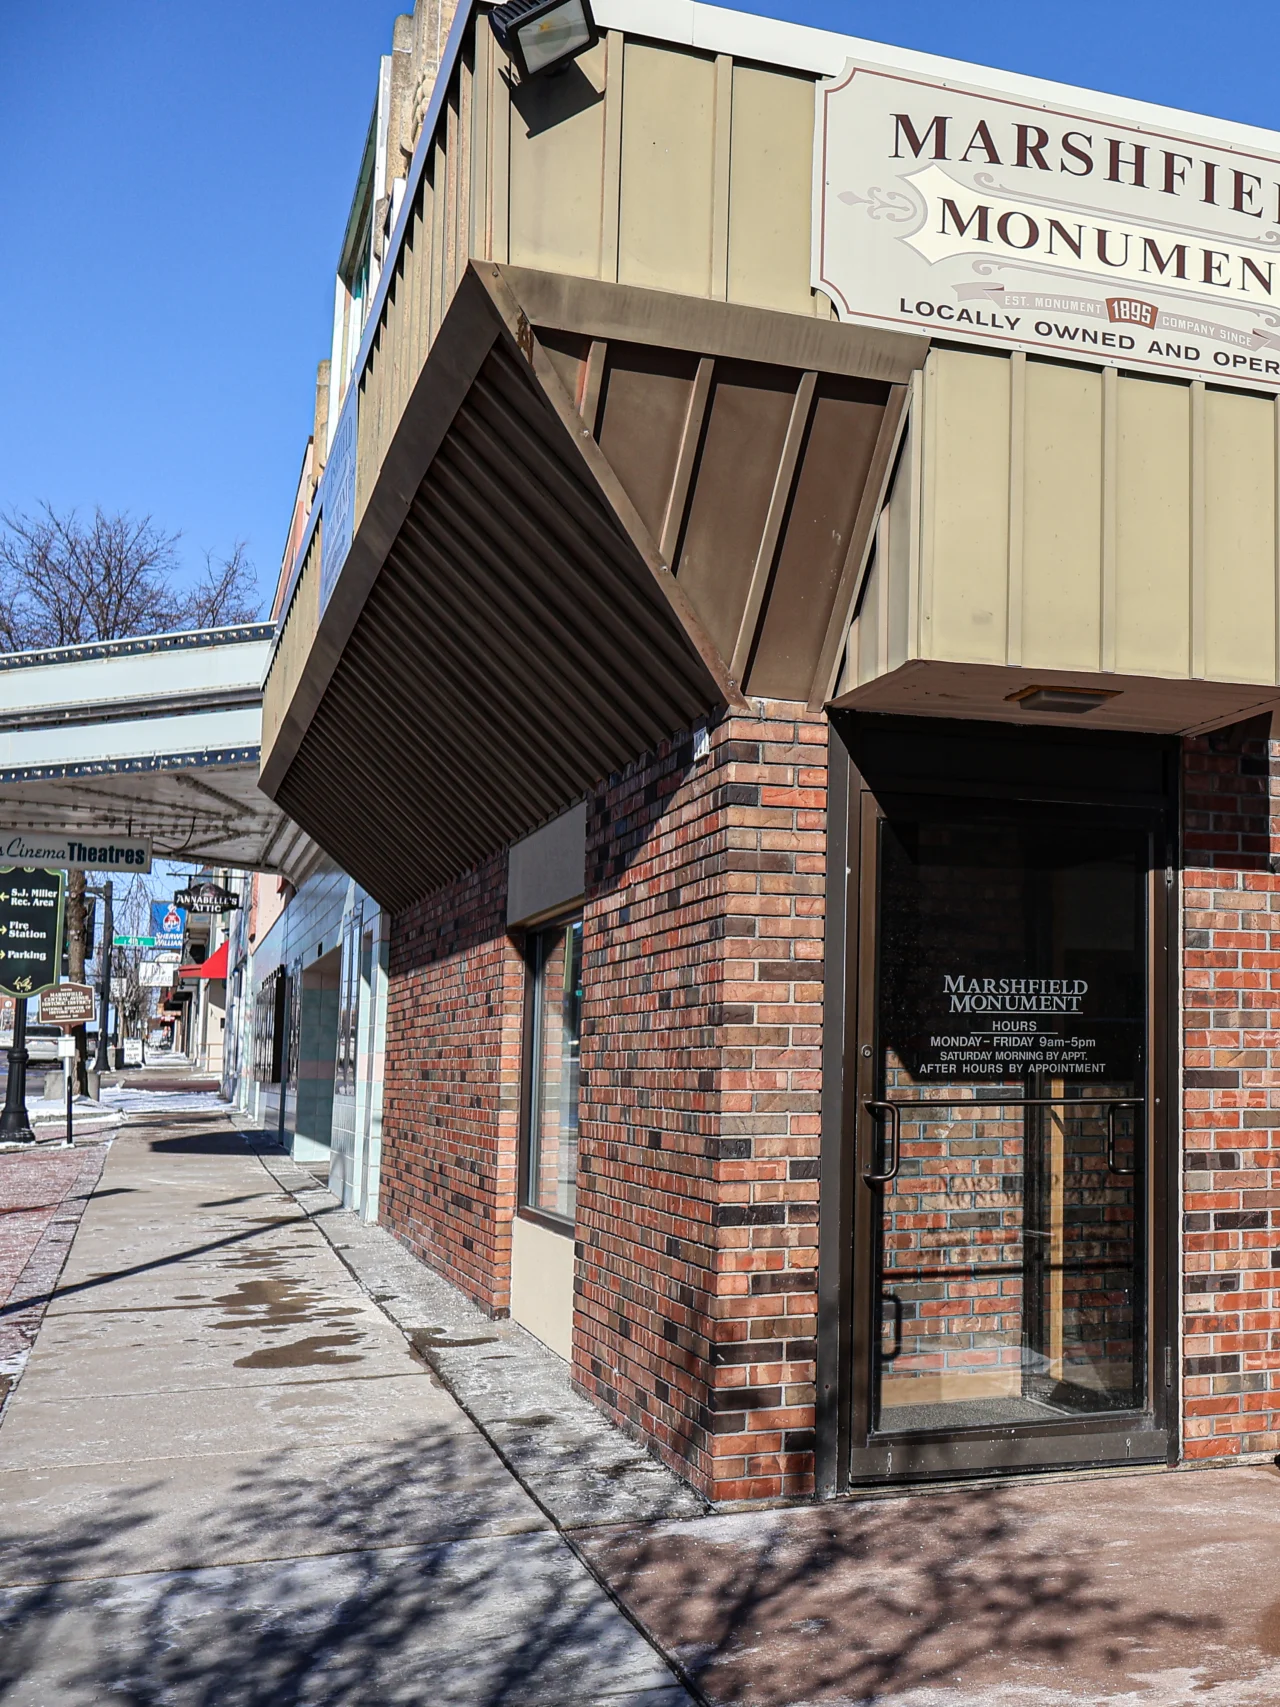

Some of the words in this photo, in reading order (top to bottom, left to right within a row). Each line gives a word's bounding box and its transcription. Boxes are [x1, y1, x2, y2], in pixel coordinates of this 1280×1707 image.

[1004, 295, 1030, 308] EST.
[1035, 297, 1102, 314] MONUMENT
[1112, 301, 1152, 325] 1895
[900, 298, 1021, 331] LOCALLY
[1034, 321, 1136, 349] OWNED
[1148, 340, 1200, 361] AND
[1162, 315, 1215, 336] COMPANY
[1220, 329, 1253, 347] SINCE
[6, 837, 66, 859] Cinema
[67, 842, 145, 865] Theatres
[11, 888, 28, 897] S.J.
[31, 889, 57, 898] Miller
[10, 898, 30, 906] Rec.
[33, 898, 54, 907] Area
[191, 903, 221, 912] ATTIC
[9, 921, 29, 931] Fire
[8, 930, 46, 939] Station
[8, 950, 46, 961] Parking
[943, 975, 1088, 995] MARSHFIELD
[949, 995, 1082, 1013] MONUMENT
[992, 1021, 1037, 1032] HOURS
[994, 1036, 1034, 1047] FRIDAY
[1039, 1037, 1096, 1049] 9am-5pm
[940, 1051, 992, 1061] SATURDAY
[995, 1051, 1043, 1061] MORNING
[1046, 1051, 1059, 1061] BY
[1061, 1051, 1088, 1061] APPT.
[919, 1064, 956, 1074] AFTER
[963, 1064, 1003, 1074] HOURS
[1009, 1064, 1023, 1074] BY
[1028, 1063, 1106, 1074] APPOINTMENT
